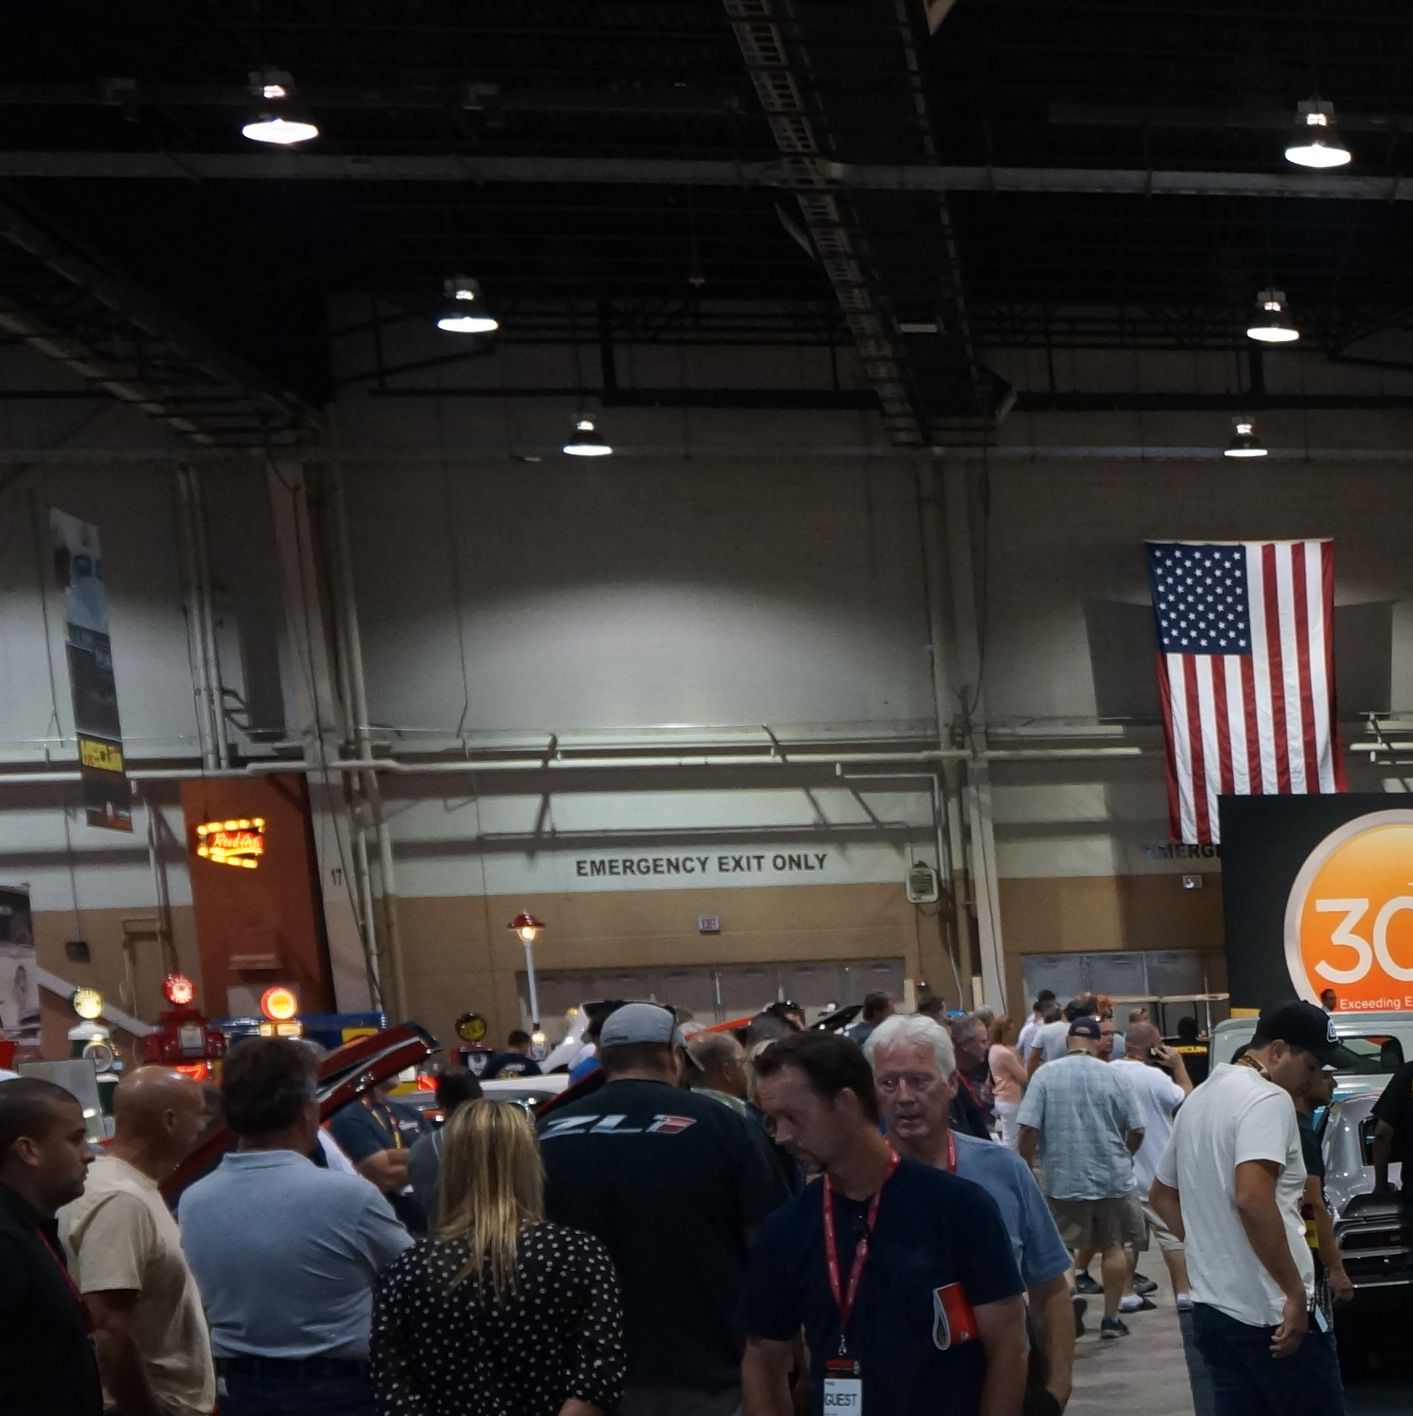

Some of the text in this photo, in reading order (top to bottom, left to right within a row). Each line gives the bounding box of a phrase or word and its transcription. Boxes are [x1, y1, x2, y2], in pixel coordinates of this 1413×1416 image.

[1144, 844, 1221, 860] EMERG
[576, 853, 827, 877] EMERGENCY EXIT ONLY
[1340, 998, 1400, 1010] Exceeding
[825, 1393, 857, 1407] GUEST
